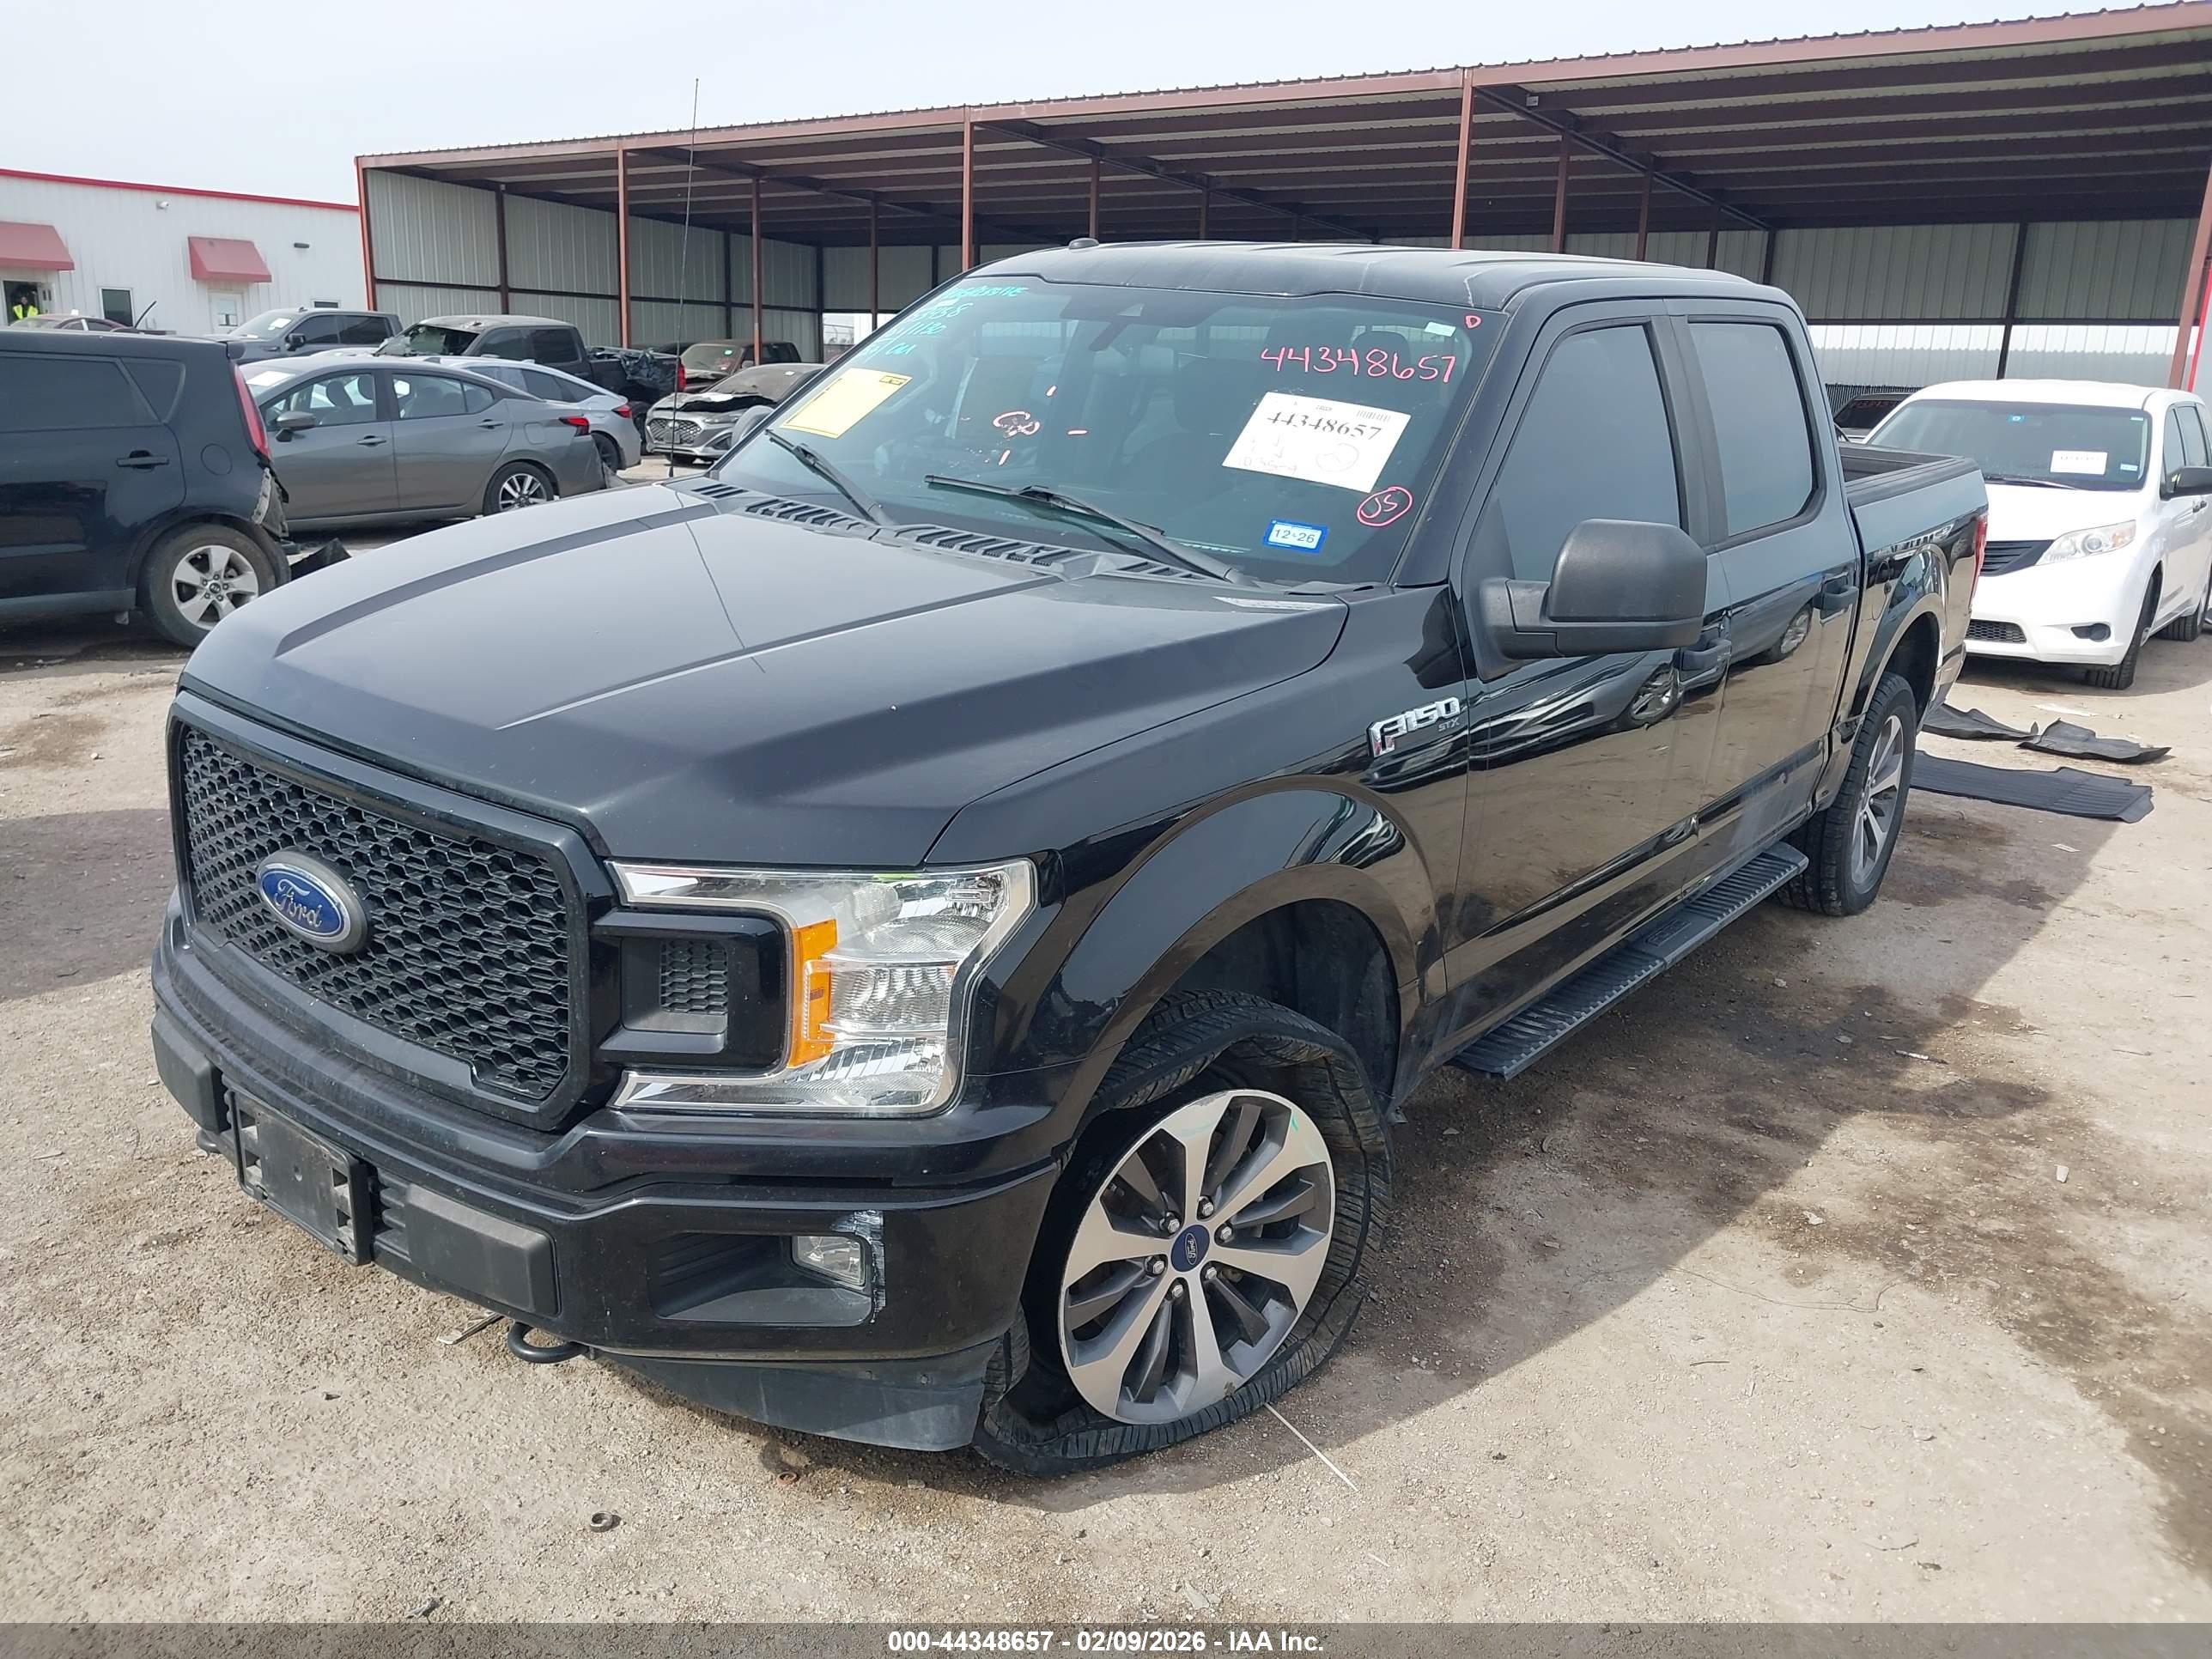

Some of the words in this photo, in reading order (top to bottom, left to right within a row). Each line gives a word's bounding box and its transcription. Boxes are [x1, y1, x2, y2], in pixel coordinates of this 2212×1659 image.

[1260, 346, 1456, 383] 44348657
[1267, 411, 1382, 441] 44348657
[1438, 717, 1460, 732] STX
[274, 878, 323, 927] Ford
